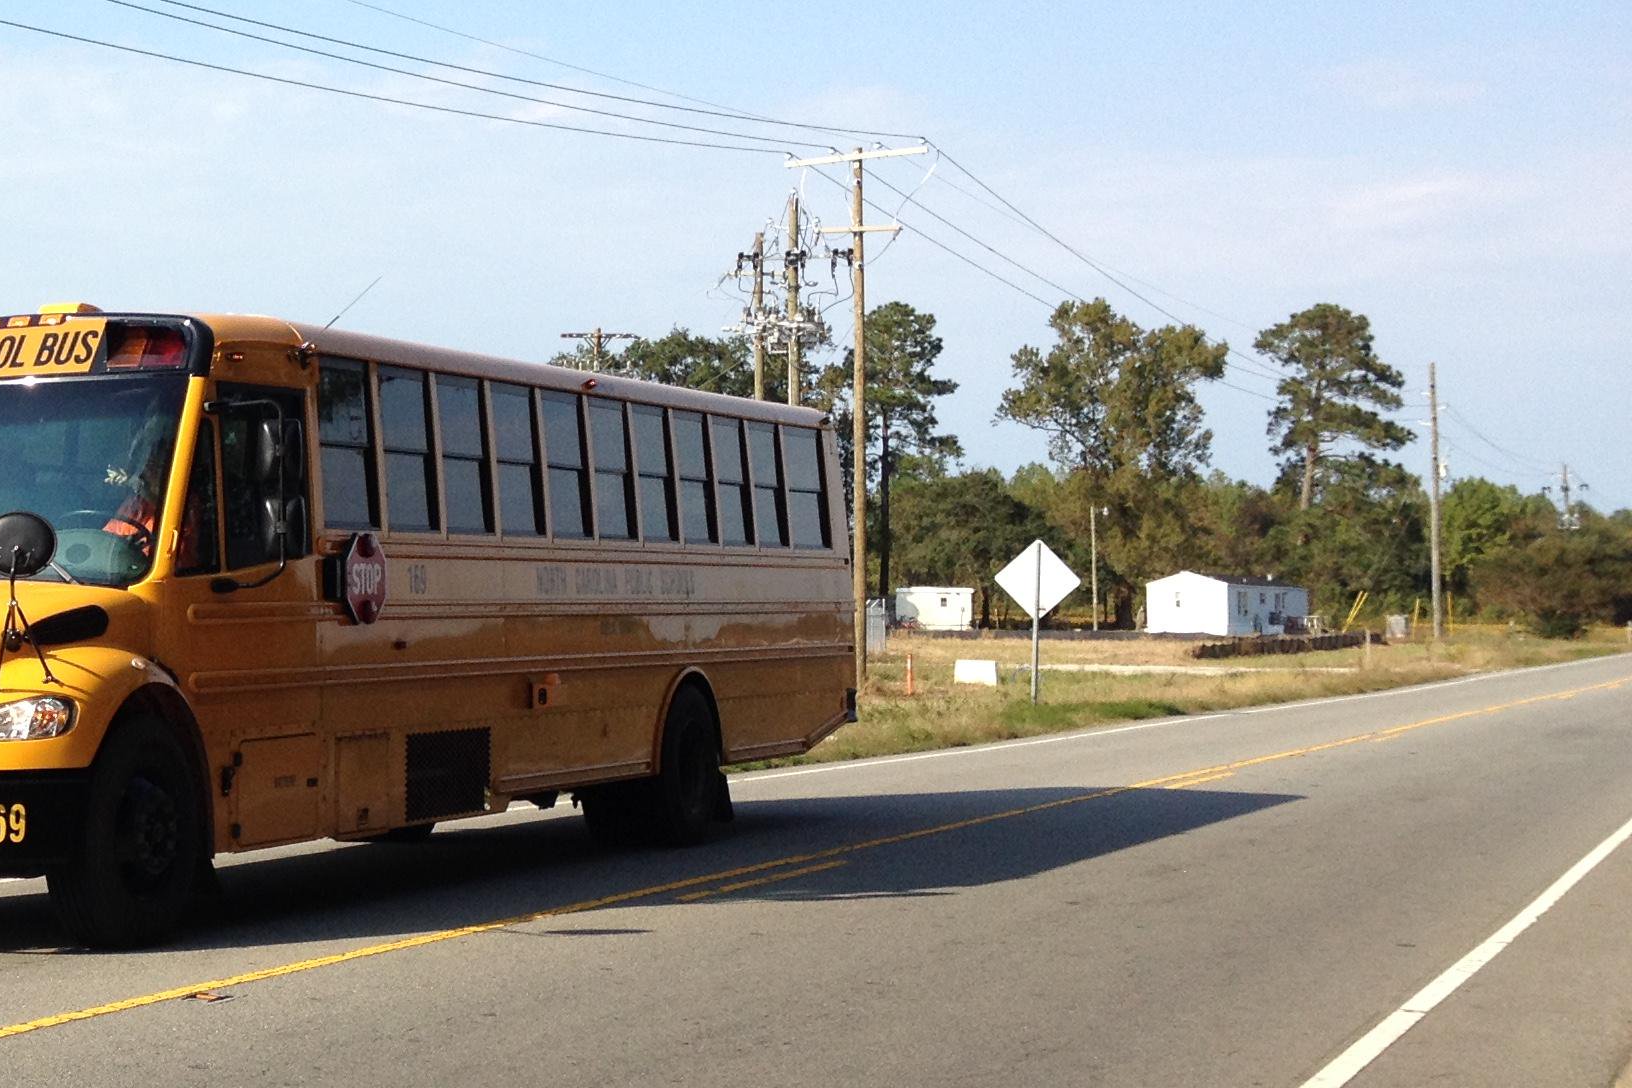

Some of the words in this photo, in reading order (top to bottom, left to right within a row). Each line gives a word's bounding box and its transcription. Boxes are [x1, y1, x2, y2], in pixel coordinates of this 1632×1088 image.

[33, 329, 99, 367] BUS
[352, 562, 382, 595] STOP
[408, 564, 427, 594] 169
